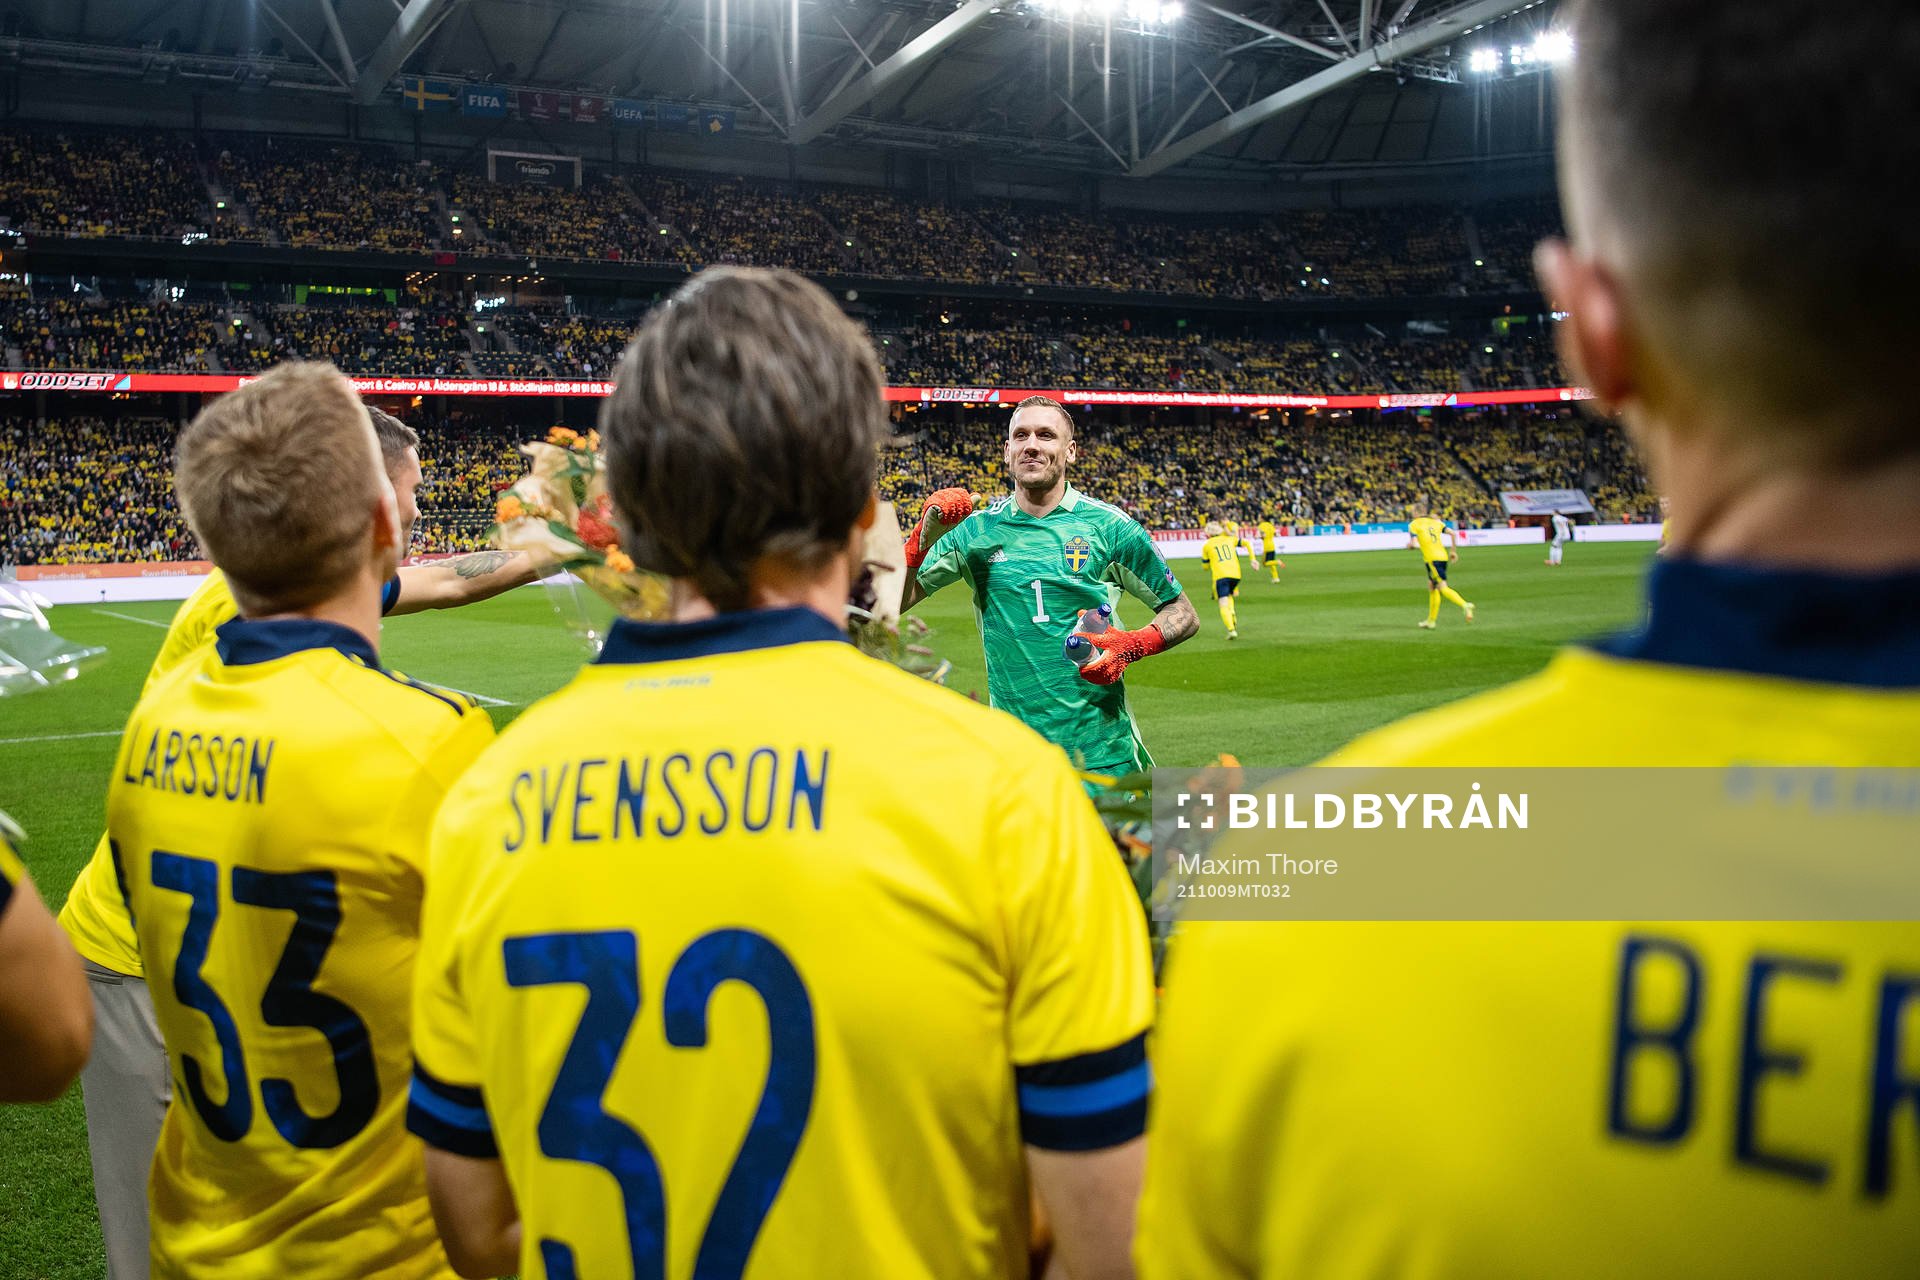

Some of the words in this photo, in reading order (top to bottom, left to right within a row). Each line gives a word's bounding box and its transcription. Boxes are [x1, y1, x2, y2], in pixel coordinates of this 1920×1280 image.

[468, 94, 501, 108] FIFA
[615, 108, 643, 121] UEFA
[20, 373, 115, 390] ODDSET
[384, 380, 417, 391] Casino
[931, 388, 989, 401] ODDSET
[1214, 544, 1232, 561] 10
[1030, 580, 1050, 624] 1
[123, 721, 275, 804] LARSSON
[504, 747, 830, 852] SVENSSON
[150, 849, 382, 1149] 33
[502, 926, 816, 1280] 32
